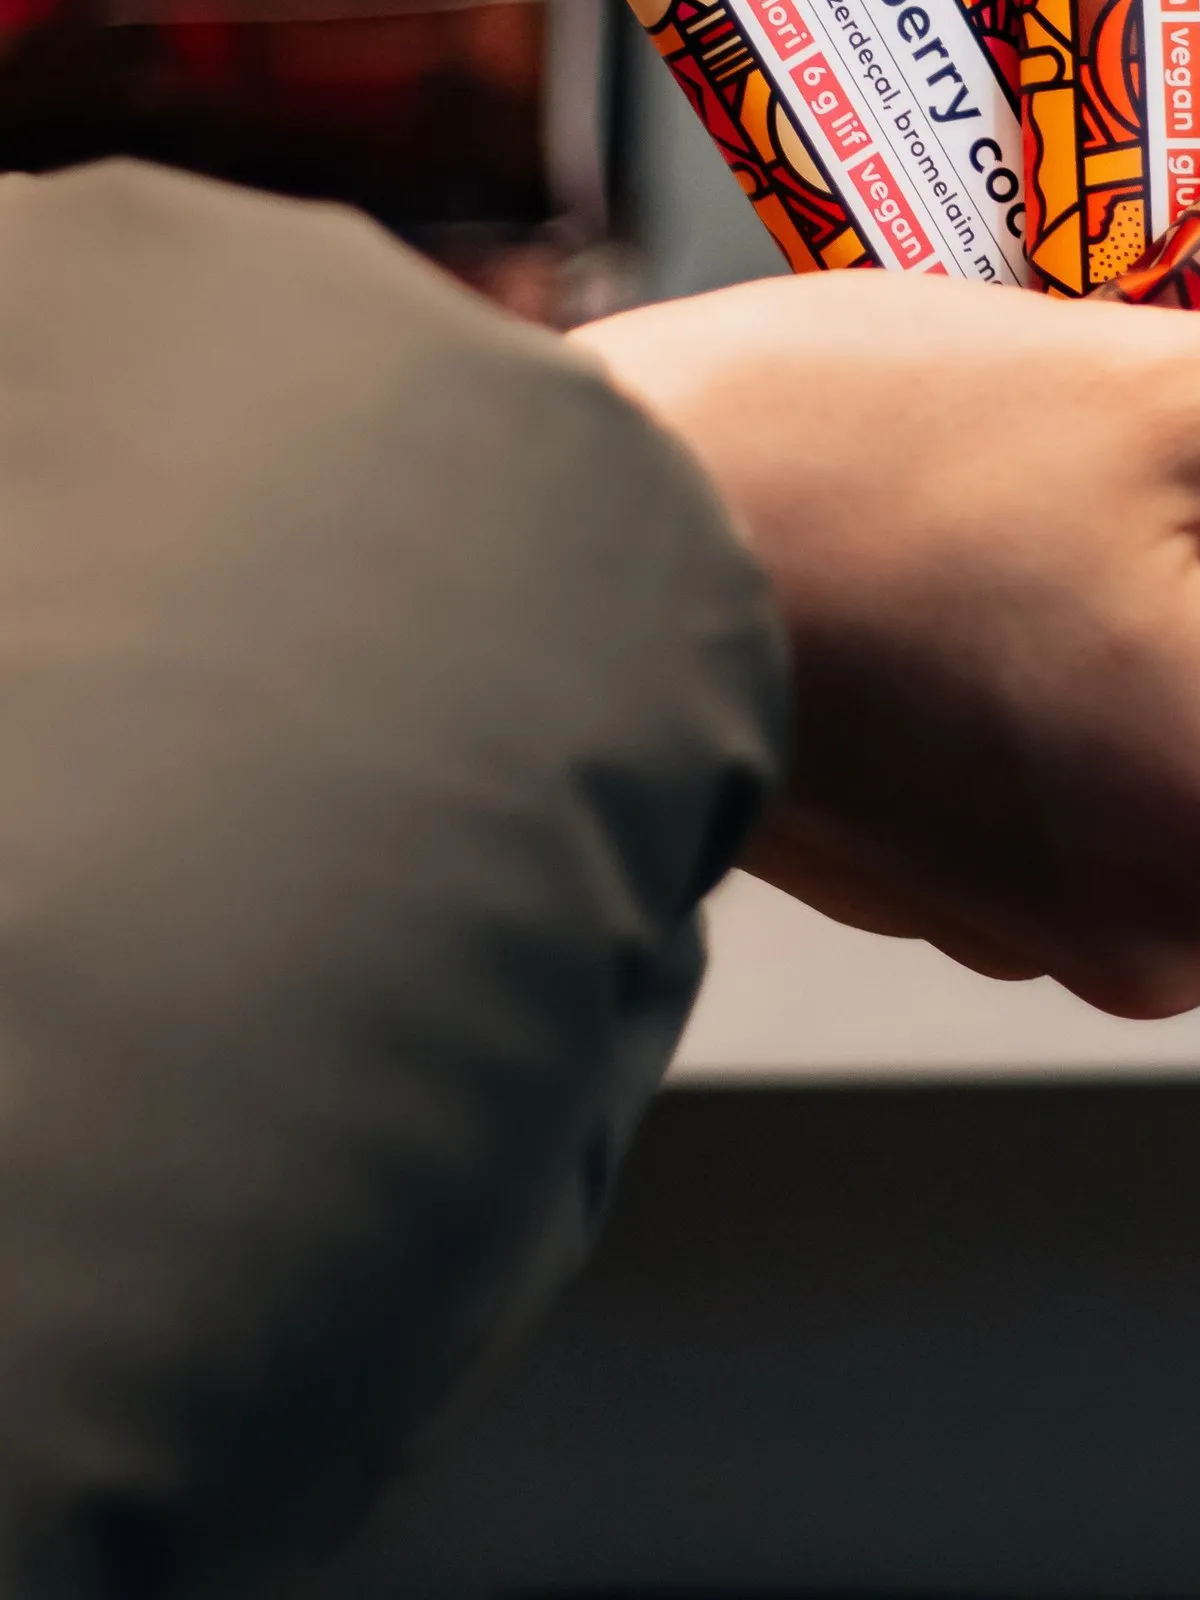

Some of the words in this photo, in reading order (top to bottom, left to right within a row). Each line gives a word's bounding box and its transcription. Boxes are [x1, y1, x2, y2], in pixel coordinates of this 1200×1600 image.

[802, 65, 823, 84] 6
[810, 89, 833, 111] g
[1164, 27, 1193, 131] vegan
[831, 112, 868, 147] lif
[860, 164, 922, 260] vegan
[893, 111, 976, 253] bromelain,
[973, 254, 1004, 285] m
[969, 137, 1028, 260] coc
